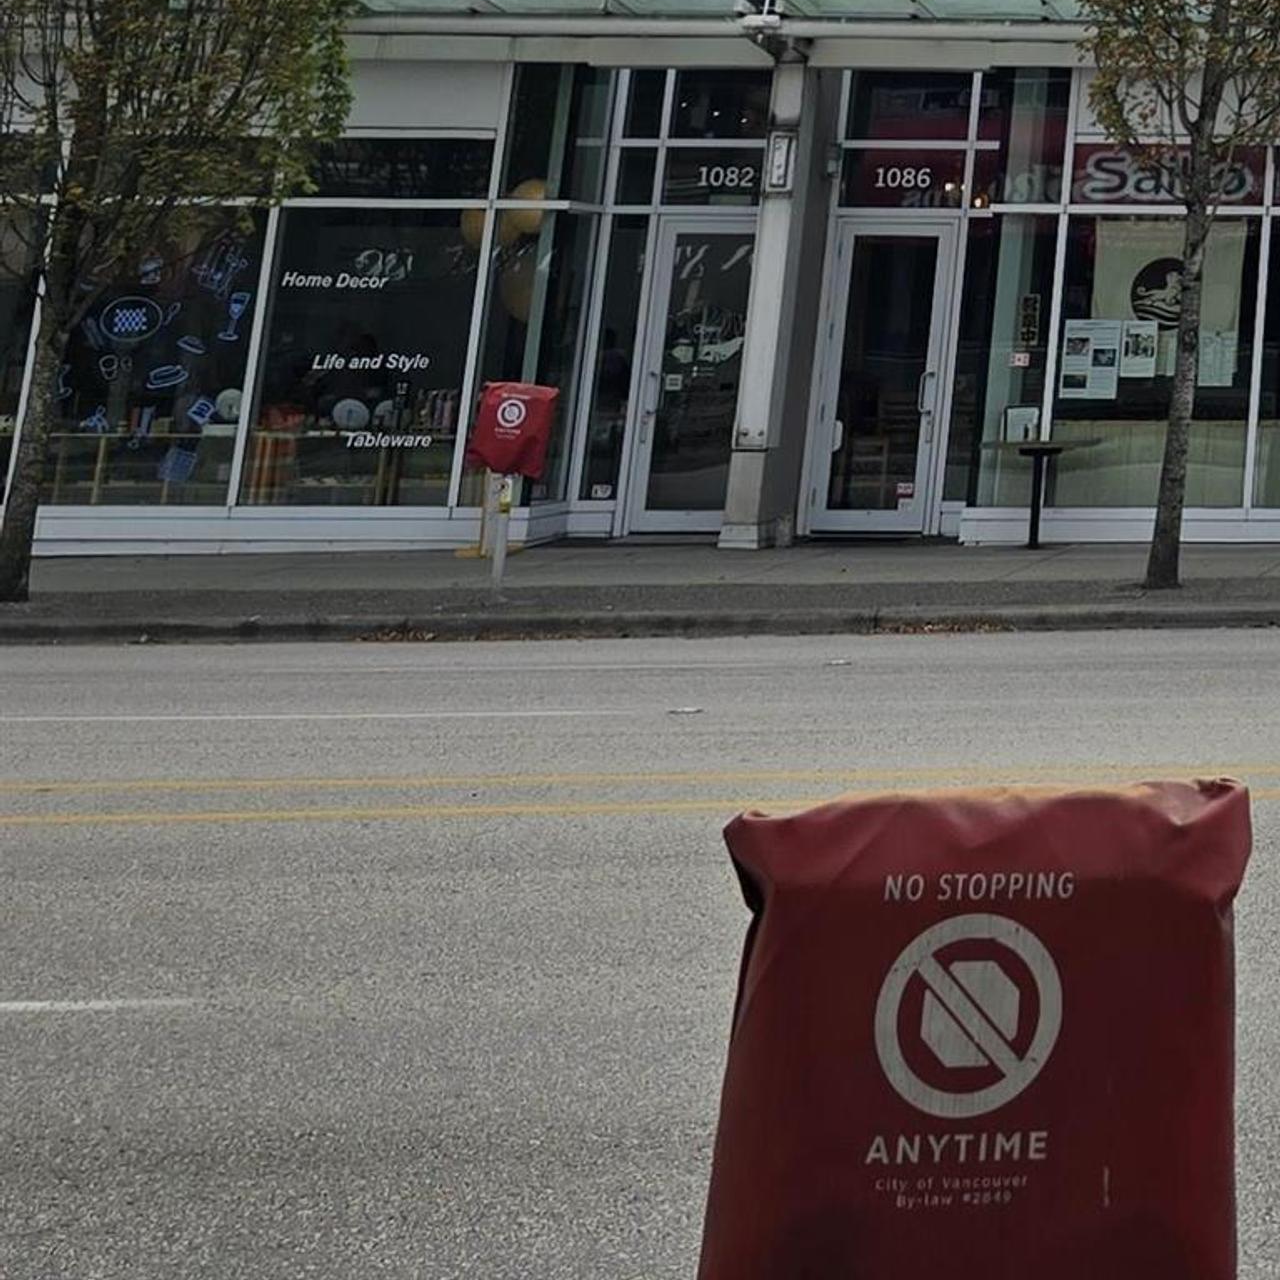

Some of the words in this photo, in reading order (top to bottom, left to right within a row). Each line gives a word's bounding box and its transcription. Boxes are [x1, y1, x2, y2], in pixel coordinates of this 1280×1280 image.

[697, 166, 755, 187] 1082
[874, 167, 931, 188] 1086
[1085, 151, 1253, 202] Saio
[282, 271, 333, 287] Home
[336, 273, 389, 289] Decor
[312, 353, 346, 370] Life
[349, 353, 384, 370] and
[386, 353, 430, 373] Style
[345, 431, 432, 448] Tableware
[884, 875, 924, 901] NO
[937, 871, 1075, 901] STOPPING
[865, 1130, 1049, 1165] ANYTIME
[875, 1177, 908, 1193] City
[917, 1177, 934, 1190] of
[942, 1173, 1029, 1190] Vancouver
[896, 1192, 953, 1209] By-law
